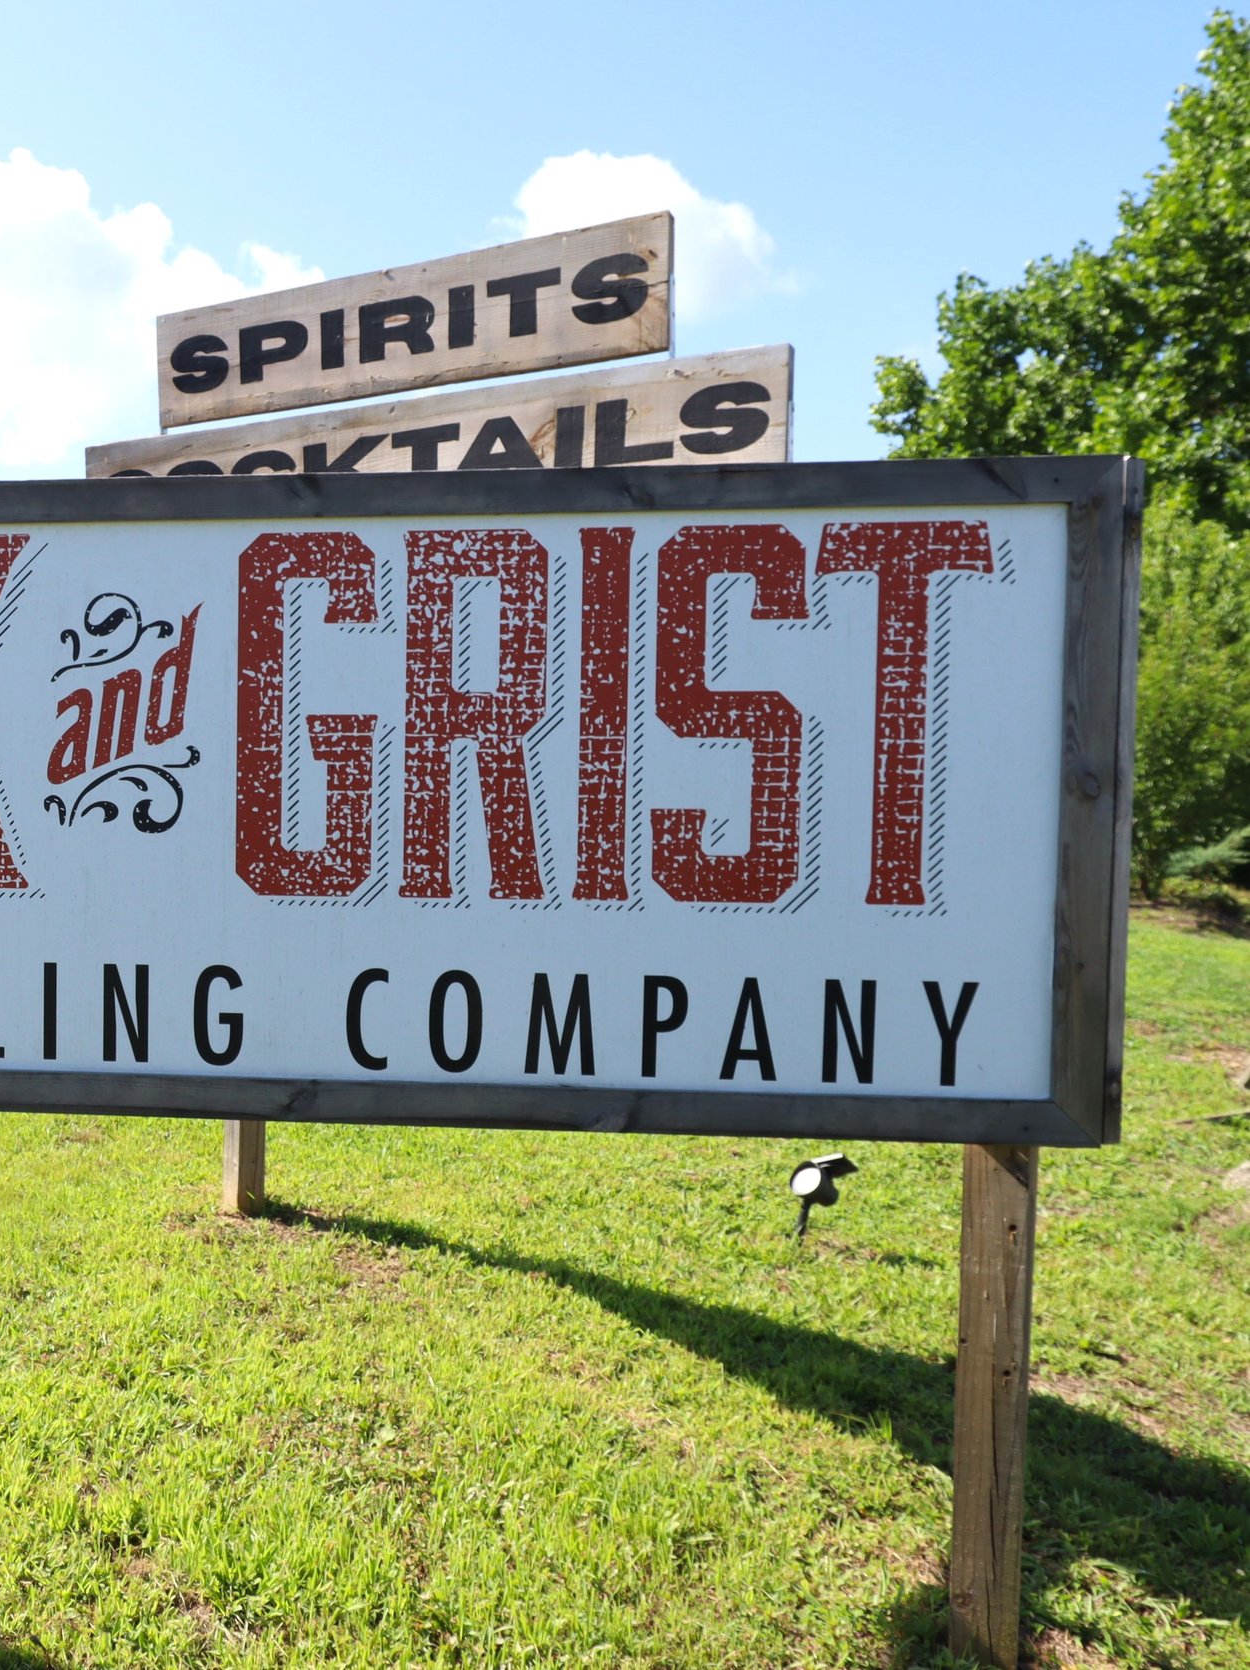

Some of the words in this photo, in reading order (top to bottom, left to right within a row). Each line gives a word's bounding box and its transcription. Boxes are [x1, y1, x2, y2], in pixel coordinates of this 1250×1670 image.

[170, 252, 649, 394] SPIRITS
[109, 381, 771, 477] KTAILS
[47, 602, 203, 785] and
[235, 520, 996, 905] GRIST
[344, 967, 980, 1087] COMPANY
